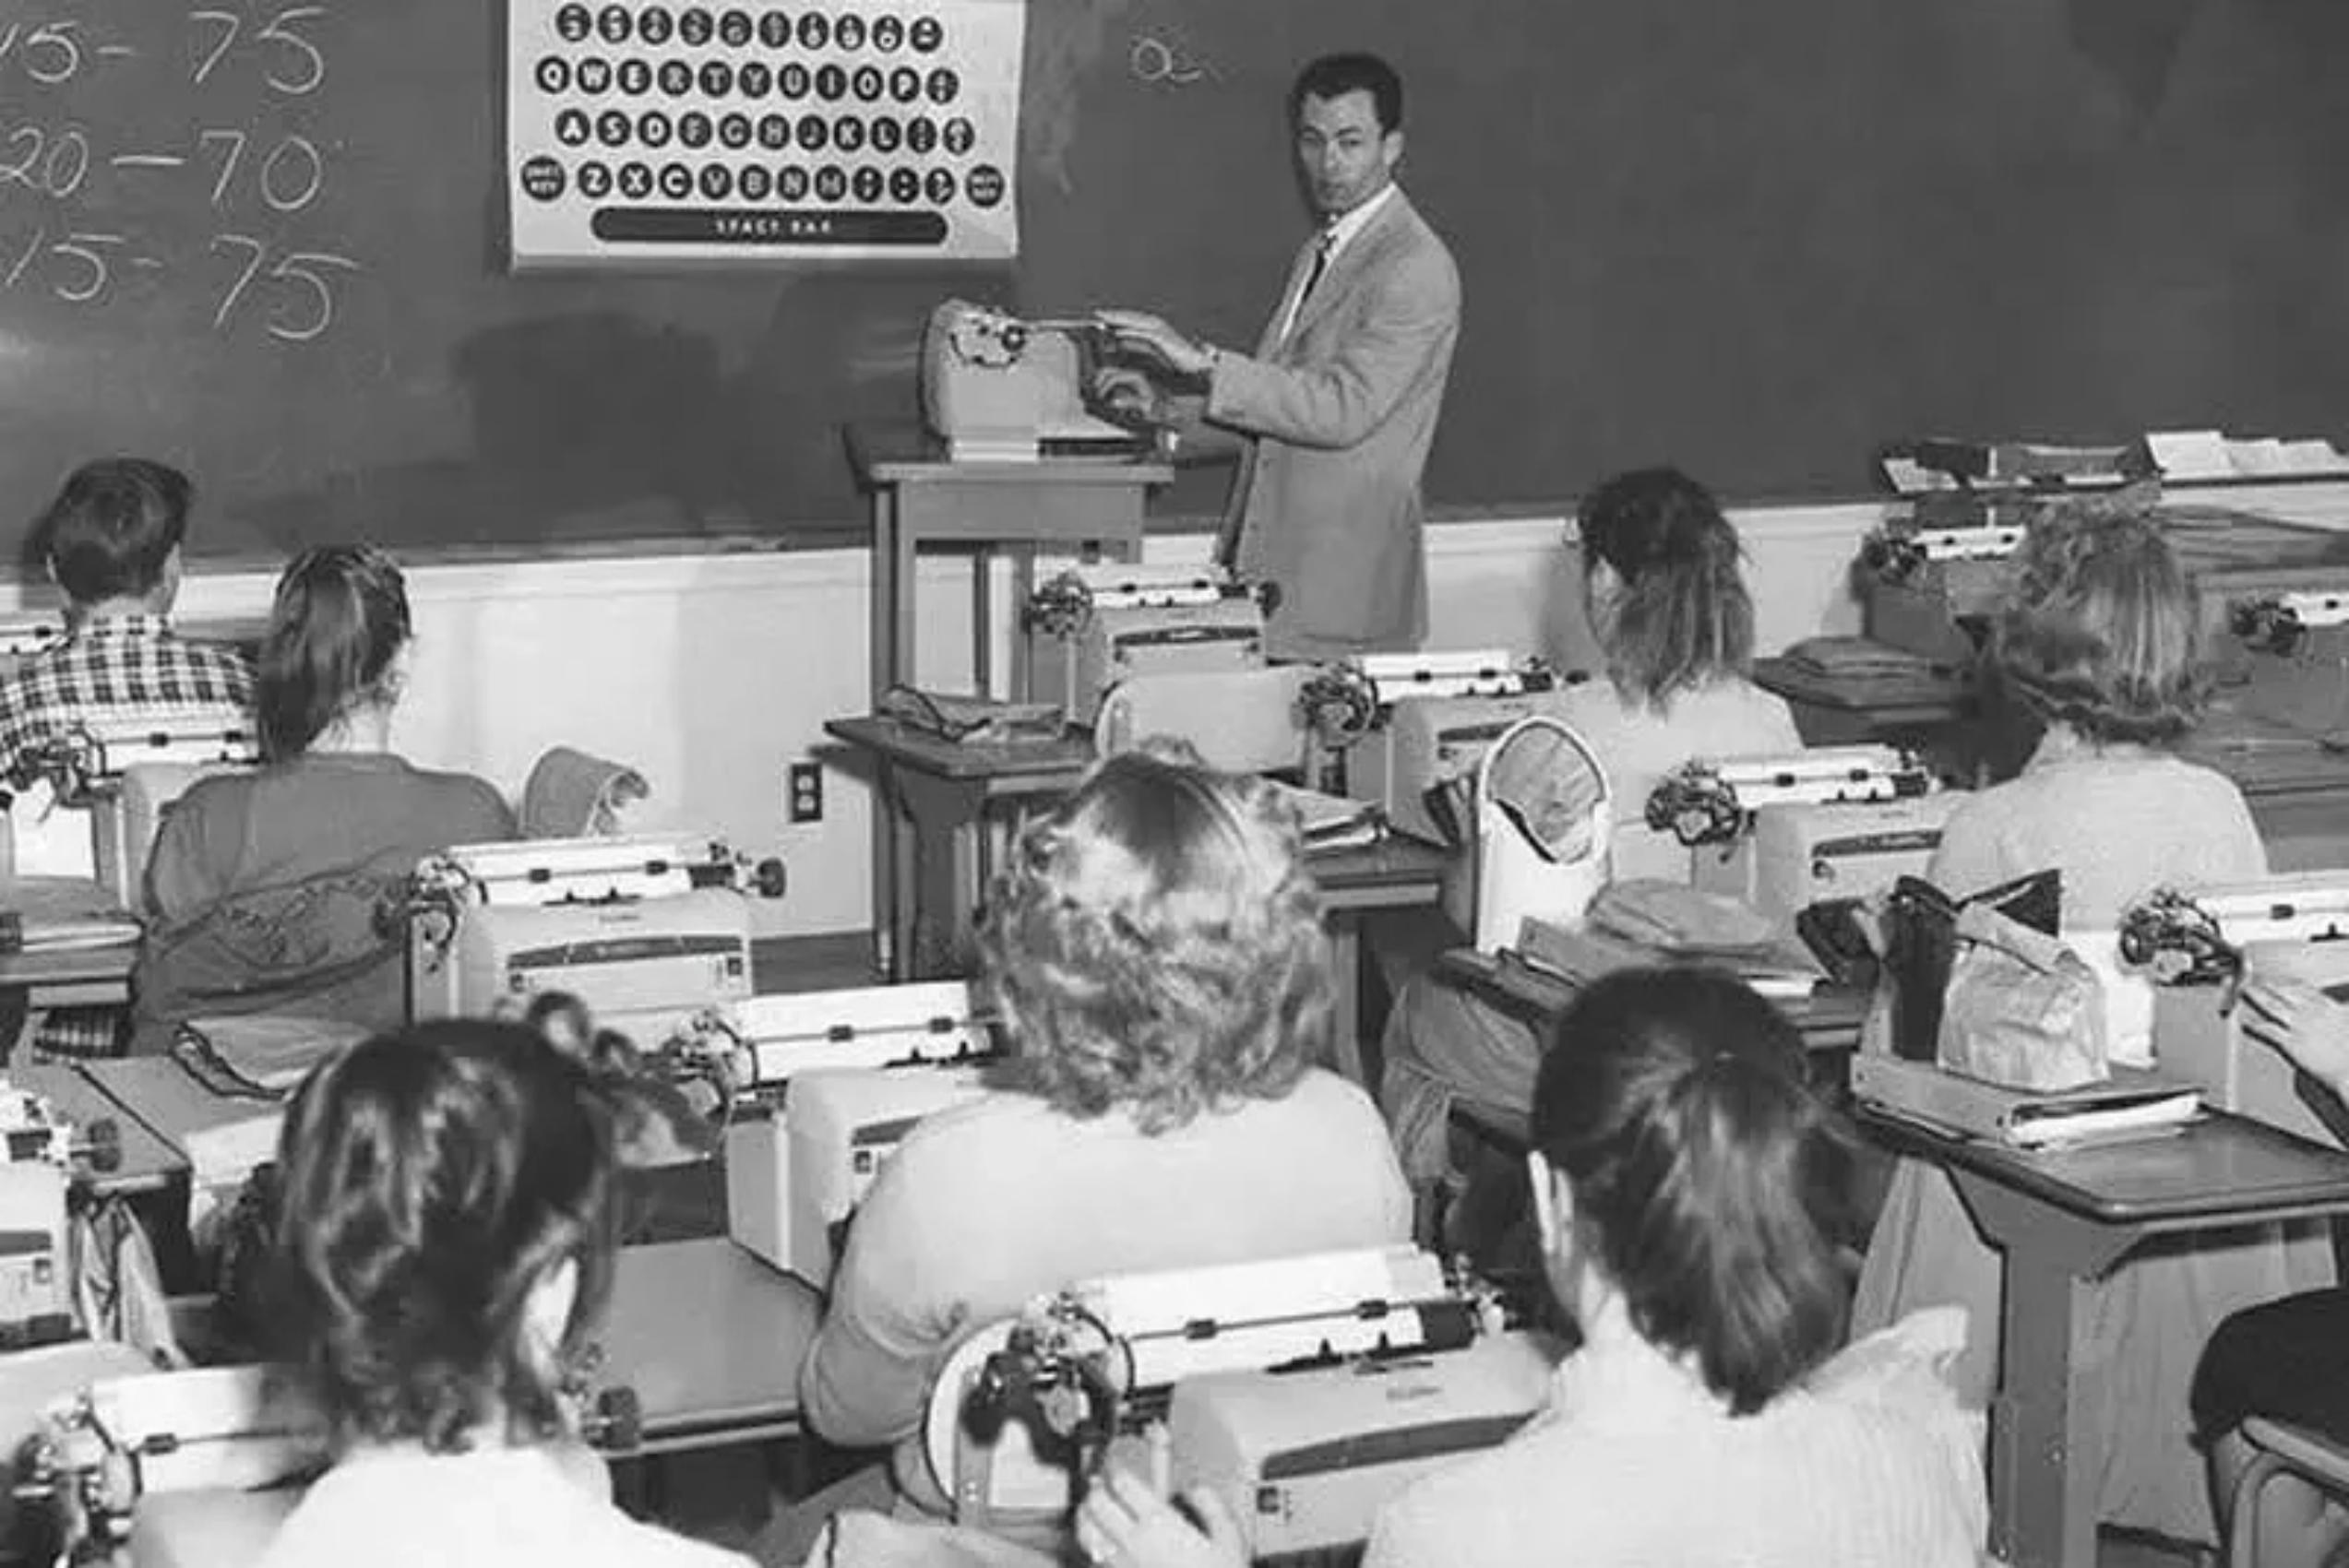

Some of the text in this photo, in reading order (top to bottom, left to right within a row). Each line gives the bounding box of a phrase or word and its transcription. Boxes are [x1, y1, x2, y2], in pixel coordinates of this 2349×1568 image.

[189, 6, 329, 94] 75
[0, 127, 89, 198] 20
[200, 130, 323, 211] 70
[6, 228, 125, 301] 15
[209, 234, 364, 339] 75
